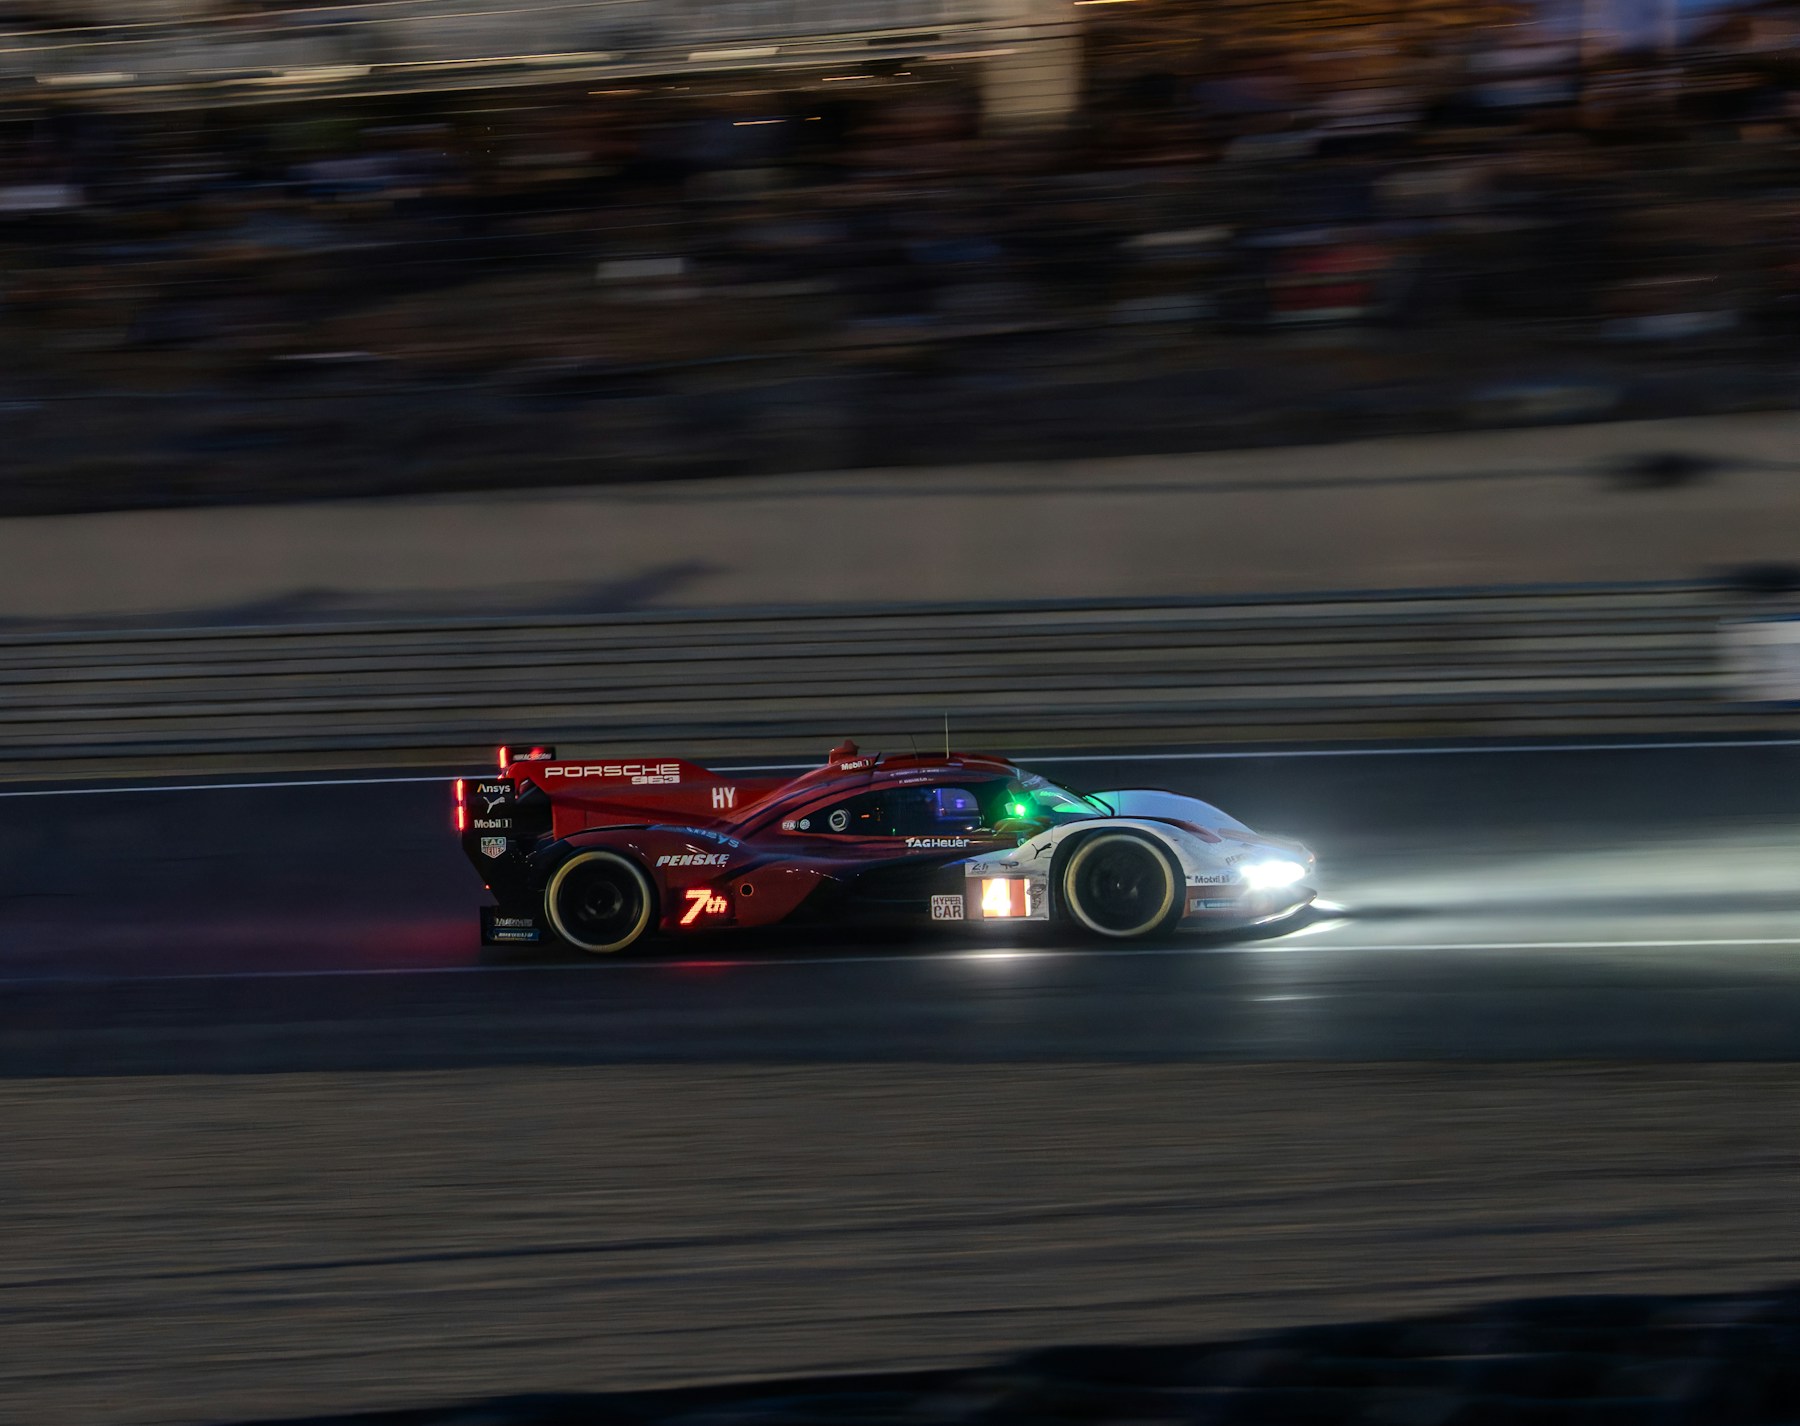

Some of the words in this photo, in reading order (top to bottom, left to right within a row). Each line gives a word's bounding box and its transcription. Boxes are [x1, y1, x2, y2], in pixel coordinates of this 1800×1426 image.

[545, 763, 680, 778] PORSCHE
[631, 775, 680, 785] 963
[477, 784, 511, 794] Ansys
[711, 787, 735, 808] HY
[474, 819, 501, 829] Mobil
[656, 853, 730, 867] PENSKE
[1195, 875, 1219, 884] Mobil
[680, 889, 727, 924] 7th
[933, 896, 961, 905] HYPER
[933, 905, 962, 919] CAR
